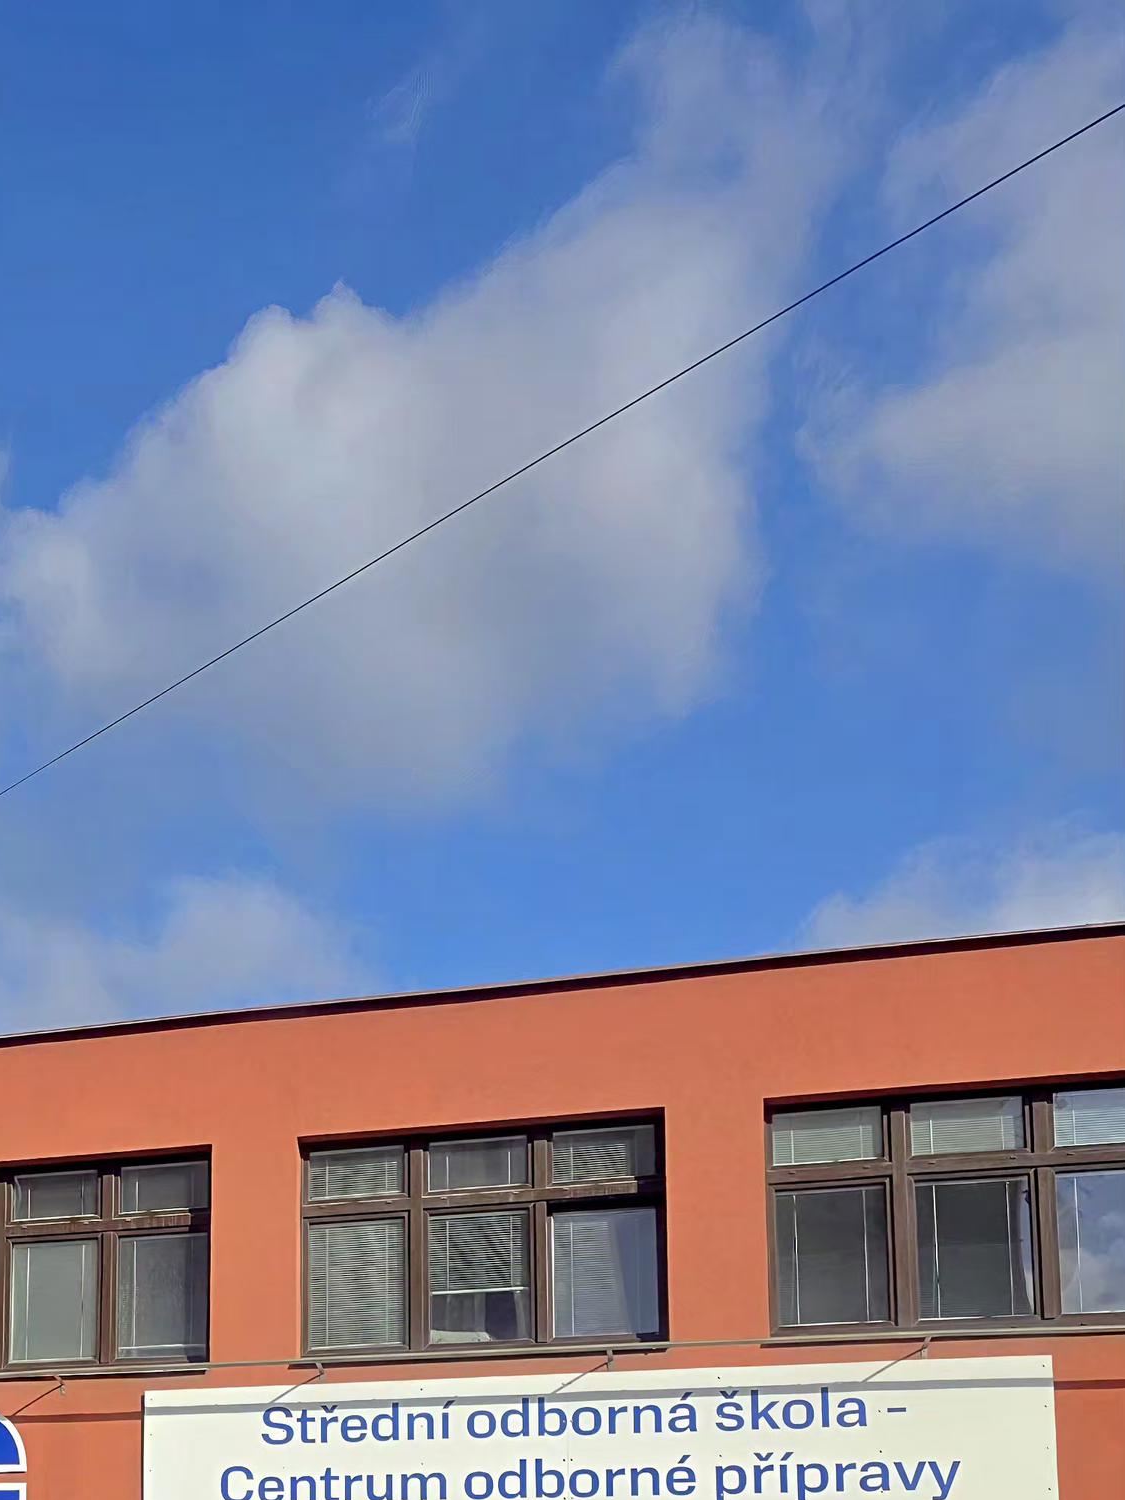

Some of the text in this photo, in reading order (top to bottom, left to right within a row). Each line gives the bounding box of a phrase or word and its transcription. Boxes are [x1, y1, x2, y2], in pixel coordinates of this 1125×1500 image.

[261, 1399, 455, 1445] Střední
[466, 1391, 699, 1440] odborná
[716, 1387, 868, 1434] škola
